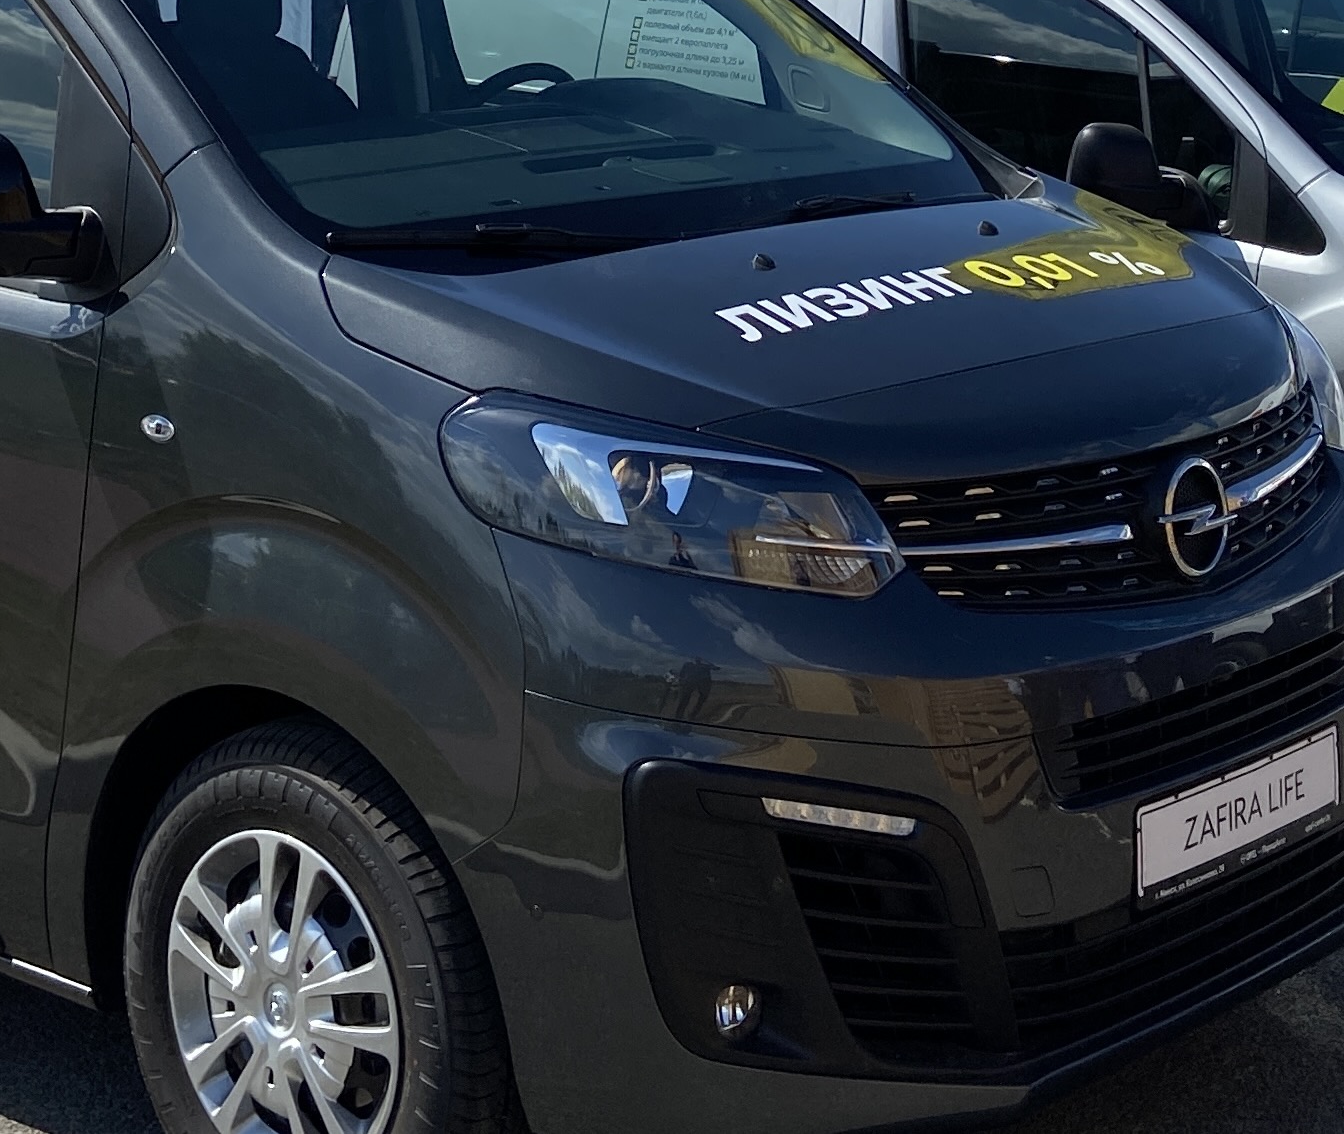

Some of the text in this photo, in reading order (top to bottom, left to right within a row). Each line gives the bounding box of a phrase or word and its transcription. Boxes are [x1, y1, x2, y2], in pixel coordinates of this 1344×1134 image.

[714, 266, 973, 343] ЛИЗИНГ
[962, 251, 1100, 292] 0,01
[1183, 790, 1264, 852] ZAFIRA
[1267, 768, 1306, 815] LIFE
